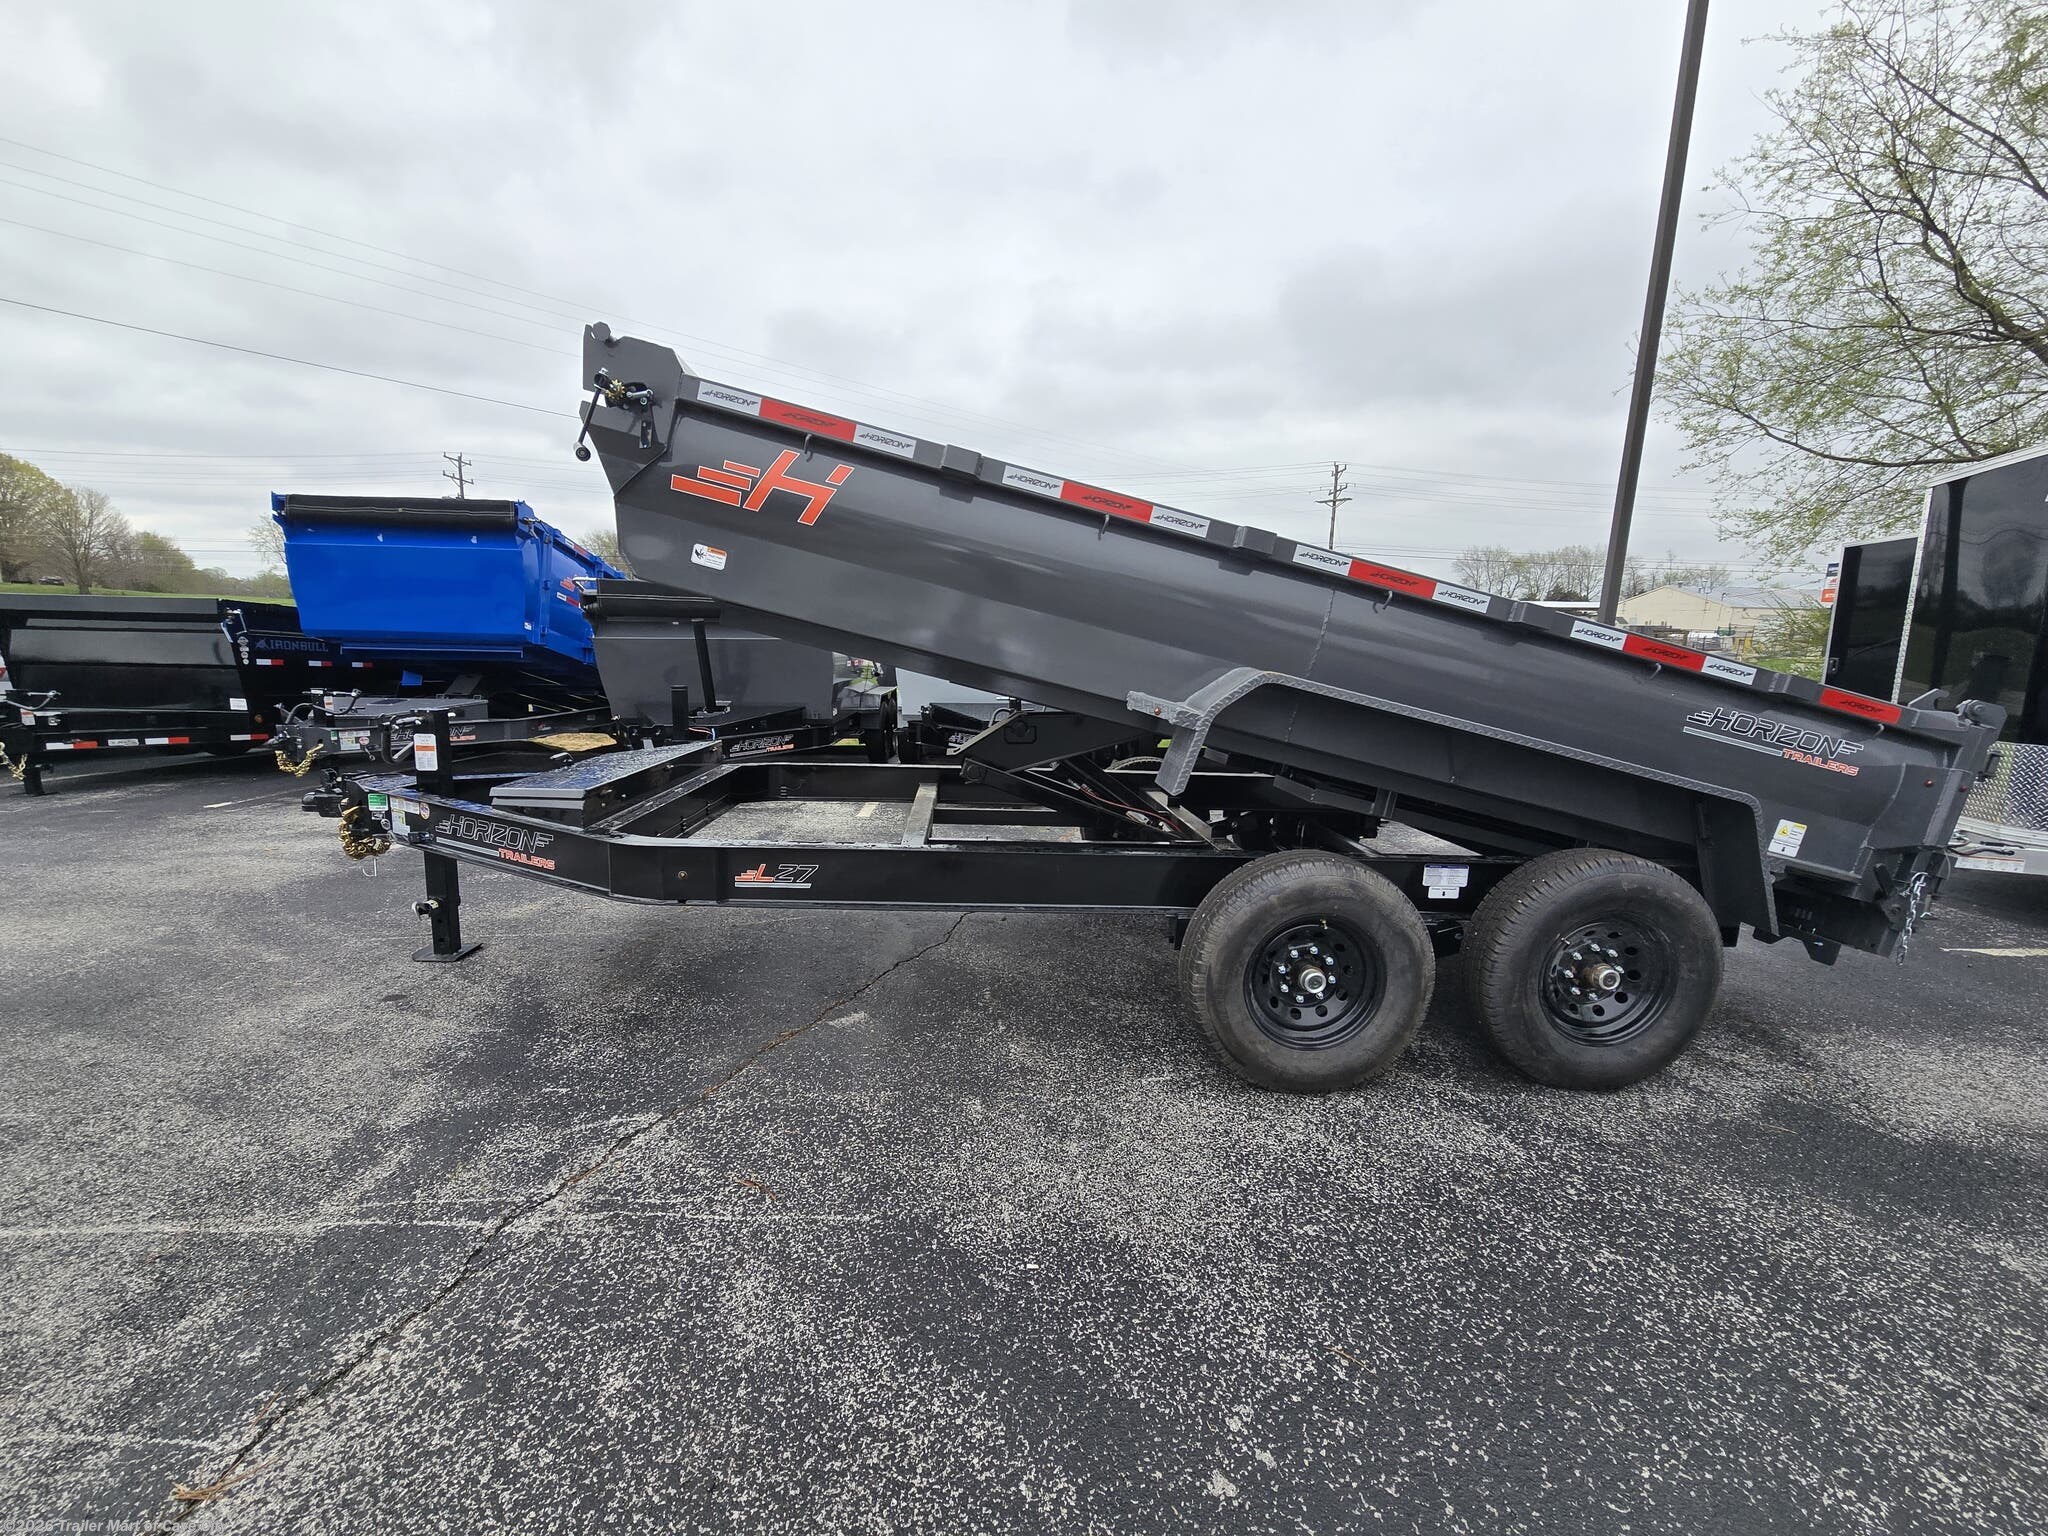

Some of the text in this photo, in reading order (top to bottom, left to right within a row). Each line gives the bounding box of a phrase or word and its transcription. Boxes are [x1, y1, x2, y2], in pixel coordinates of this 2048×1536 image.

[704, 389, 756, 407] HORIZON
[861, 433, 911, 449] HORIZON
[1009, 473, 1058, 490] HORIZON
[1156, 514, 1203, 530] HORIZON
[1301, 551, 1348, 568] HORIZON
[1440, 590, 1486, 606] HORIZON
[1577, 627, 1620, 642] HORIZON
[1698, 707, 1853, 759] HORIZON
[733, 734, 791, 752] HORIZON
[1783, 748, 1860, 777] TRAILERS
[442, 814, 546, 853] HORIZON
[498, 848, 555, 871] TRAILERS
